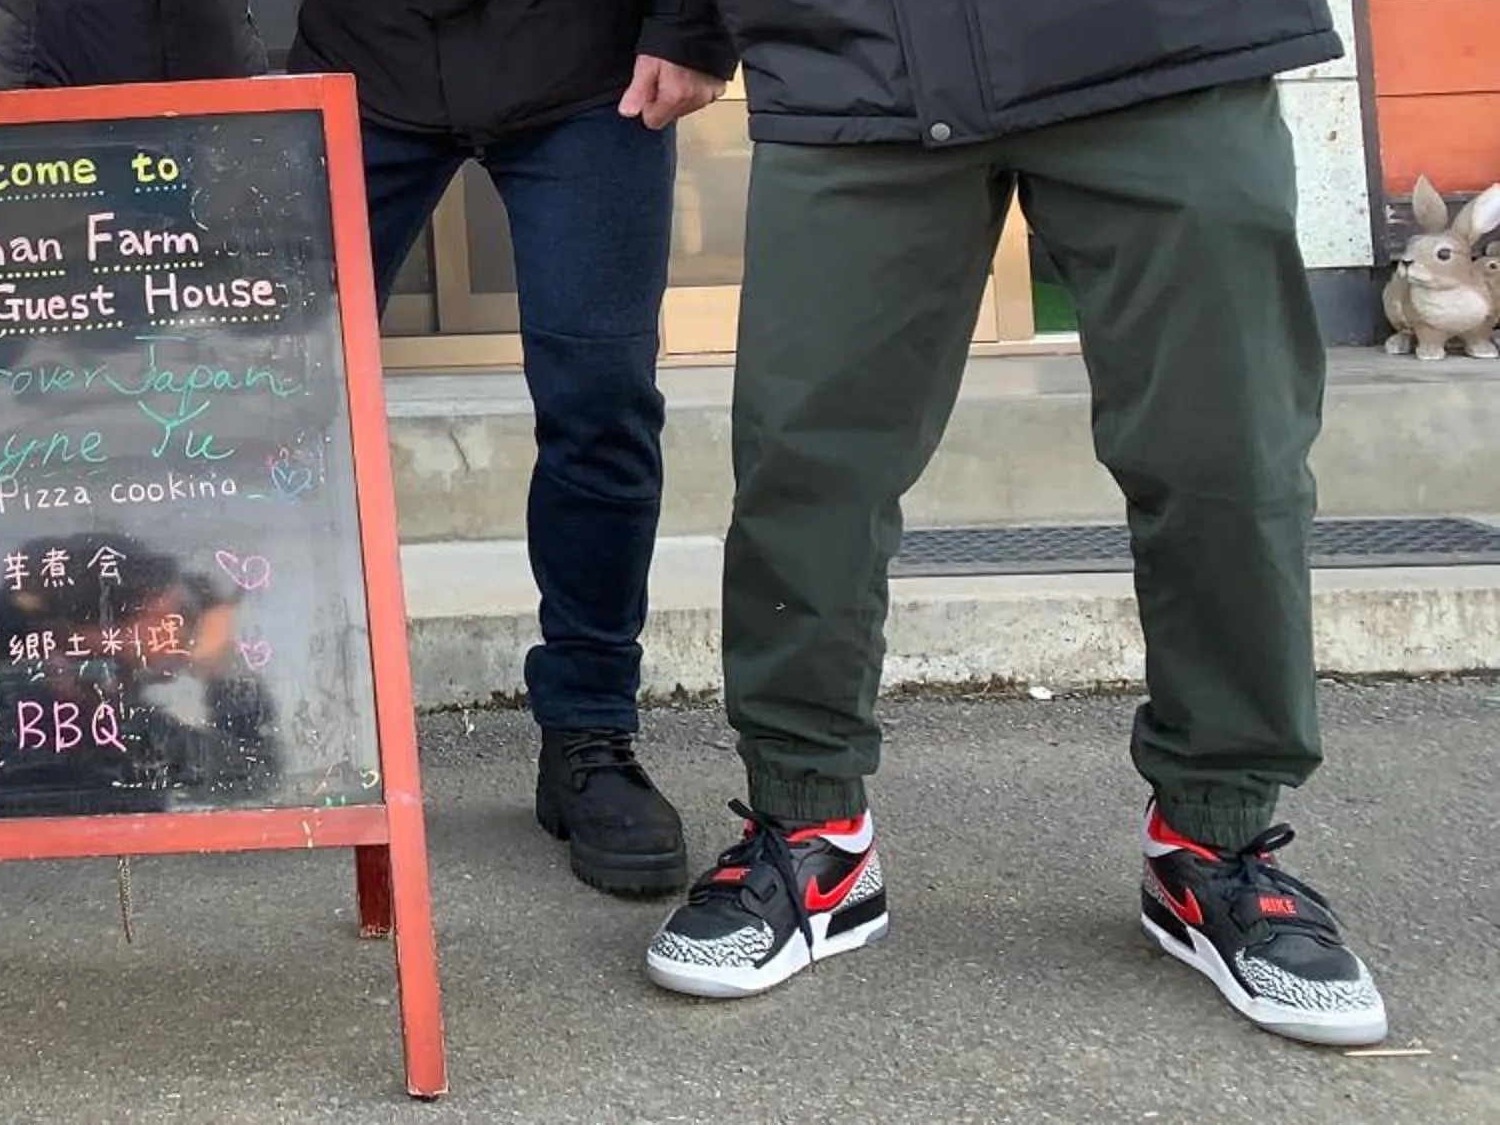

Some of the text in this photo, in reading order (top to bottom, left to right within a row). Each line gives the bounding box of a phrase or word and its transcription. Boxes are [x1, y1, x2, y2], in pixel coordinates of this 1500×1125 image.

[132, 151, 179, 183] to
[86, 212, 200, 262] Farm
[145, 274, 277, 315] House
[103, 335, 303, 417] Japan
[3, 546, 127, 591] 芋煮会
[8, 614, 193, 666] 郷土料理
[17, 700, 128, 753] BBQ
